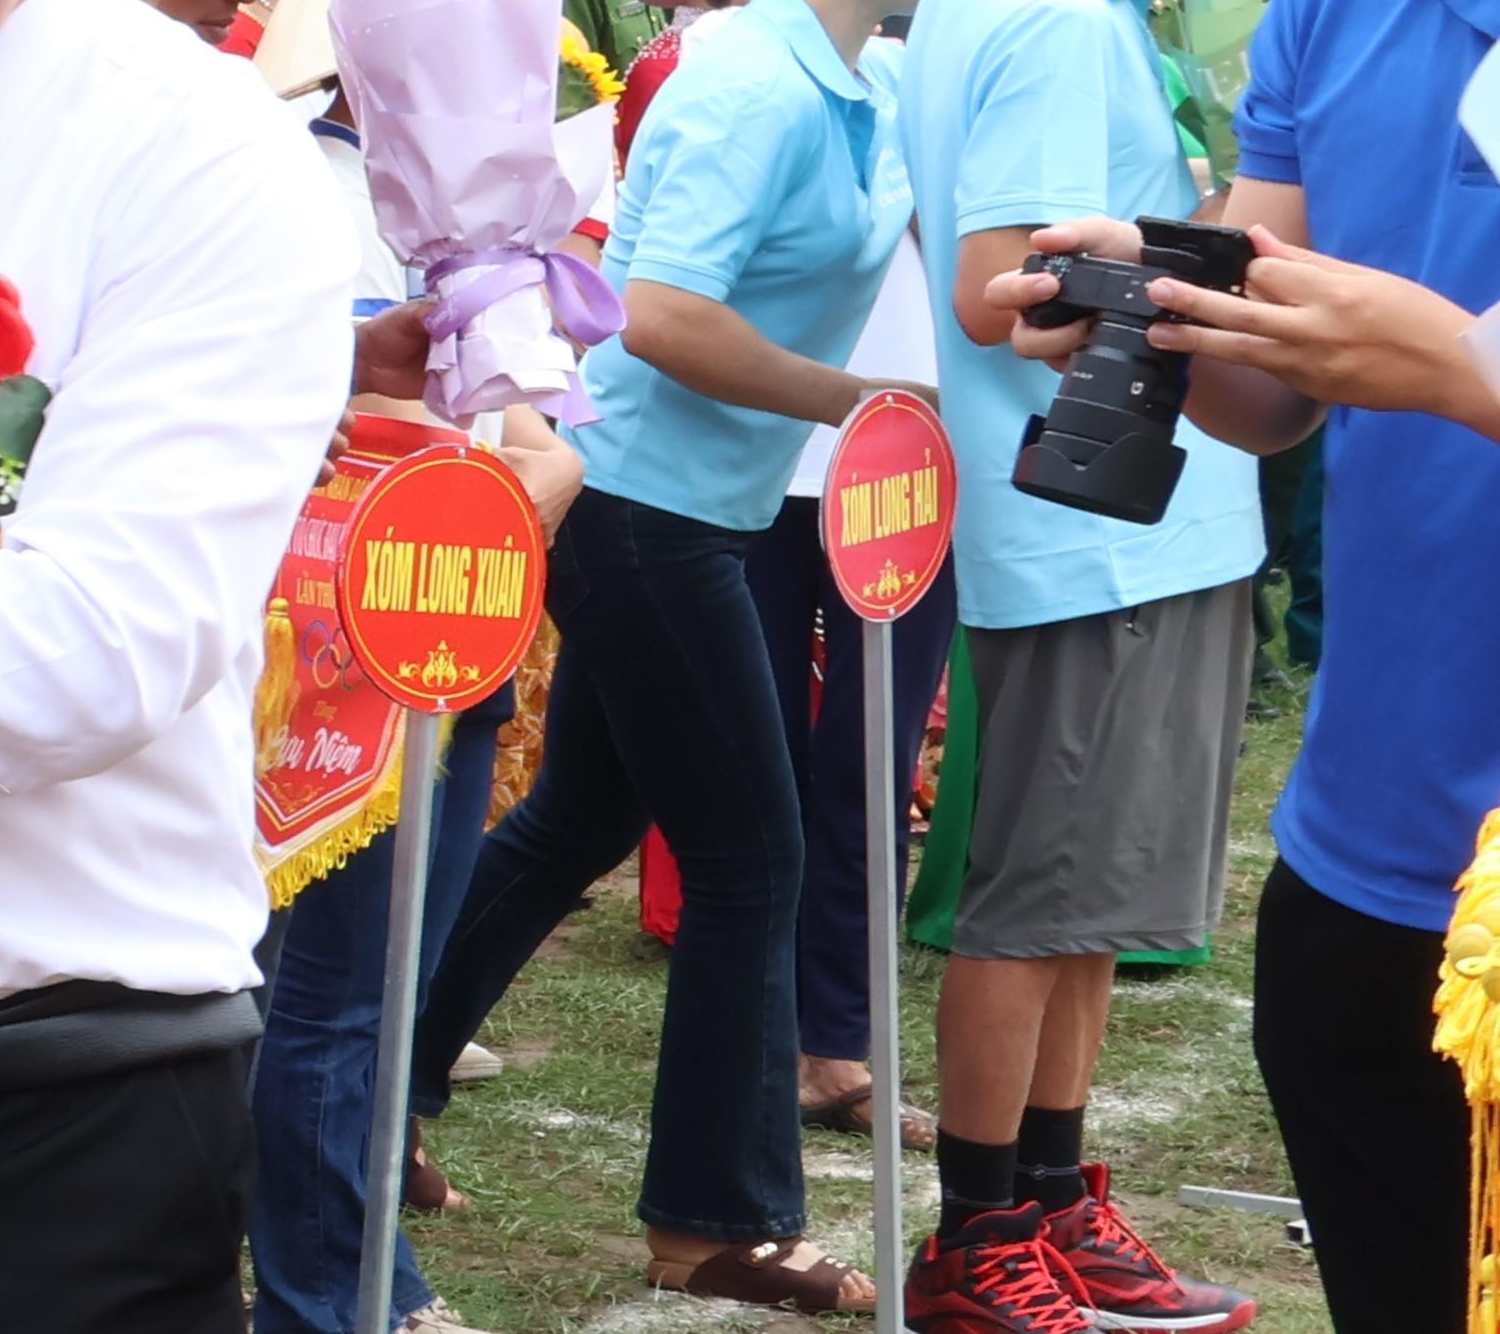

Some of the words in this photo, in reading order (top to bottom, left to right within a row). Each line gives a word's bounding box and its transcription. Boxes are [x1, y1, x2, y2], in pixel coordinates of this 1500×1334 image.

[840, 472, 872, 548] XÓM
[874, 472, 911, 539] LONG
[361, 526, 415, 612] XÓM
[415, 543, 472, 616] LONG
[471, 535, 527, 620] XUÂN
